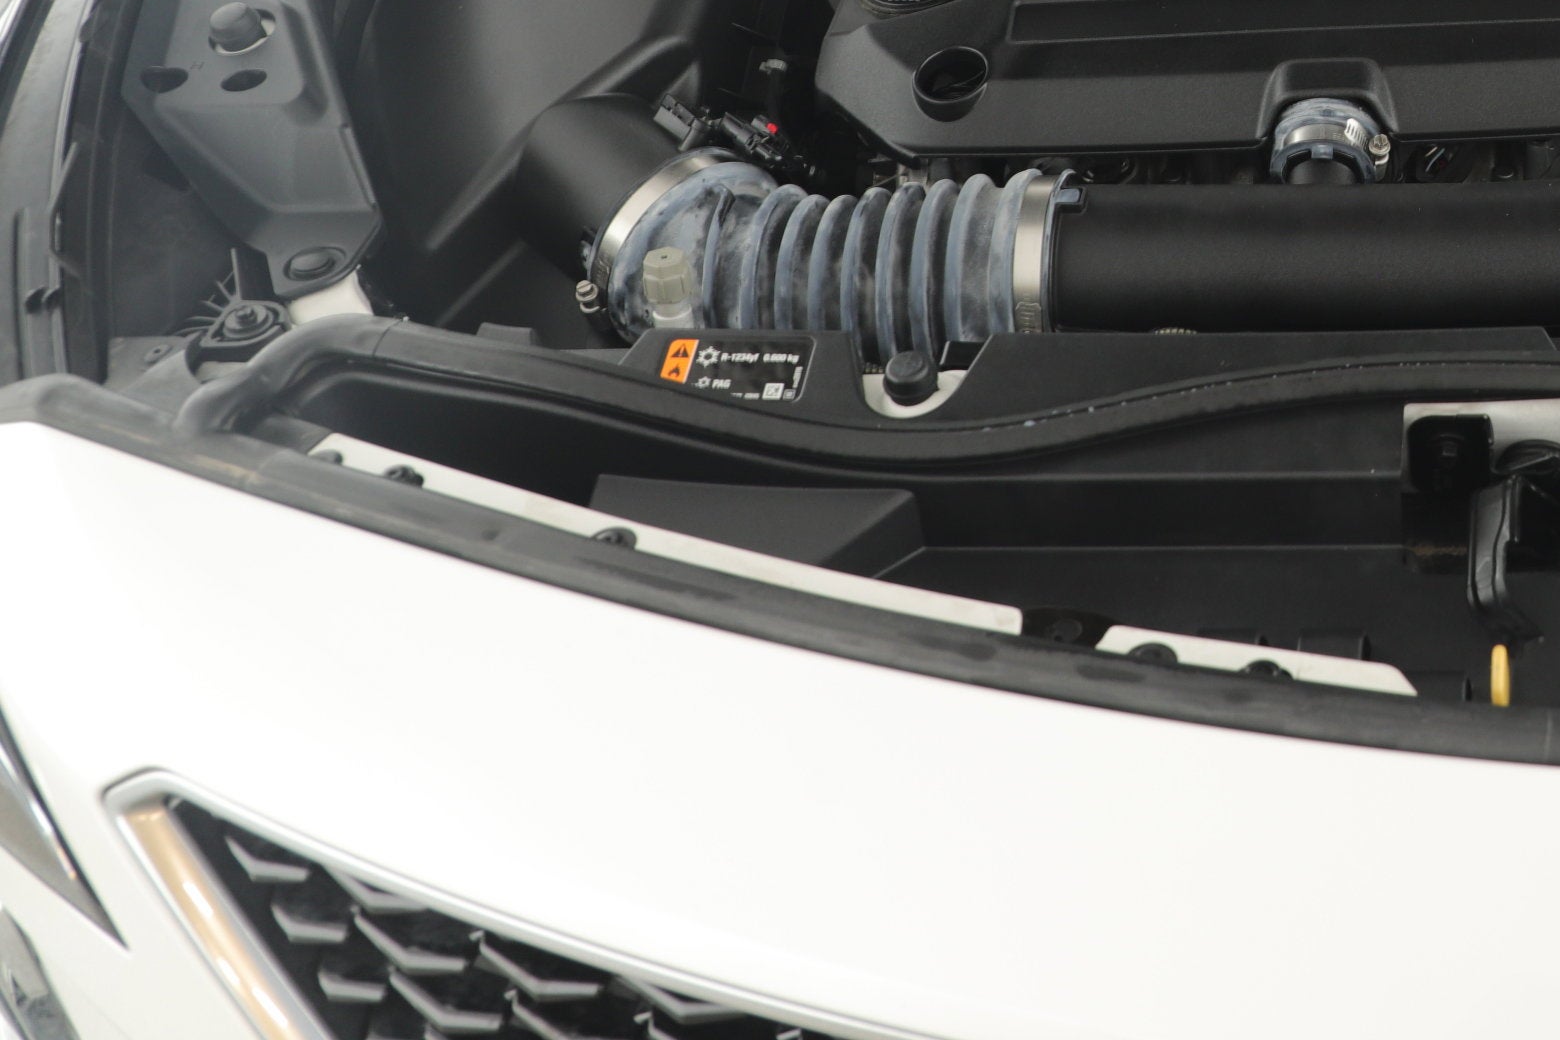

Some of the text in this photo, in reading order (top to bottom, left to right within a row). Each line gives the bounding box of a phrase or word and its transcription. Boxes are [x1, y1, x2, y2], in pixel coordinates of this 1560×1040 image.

[721, 352, 760, 364] R-1234yf
[787, 353, 800, 365] kg
[712, 378, 732, 389] PAG
